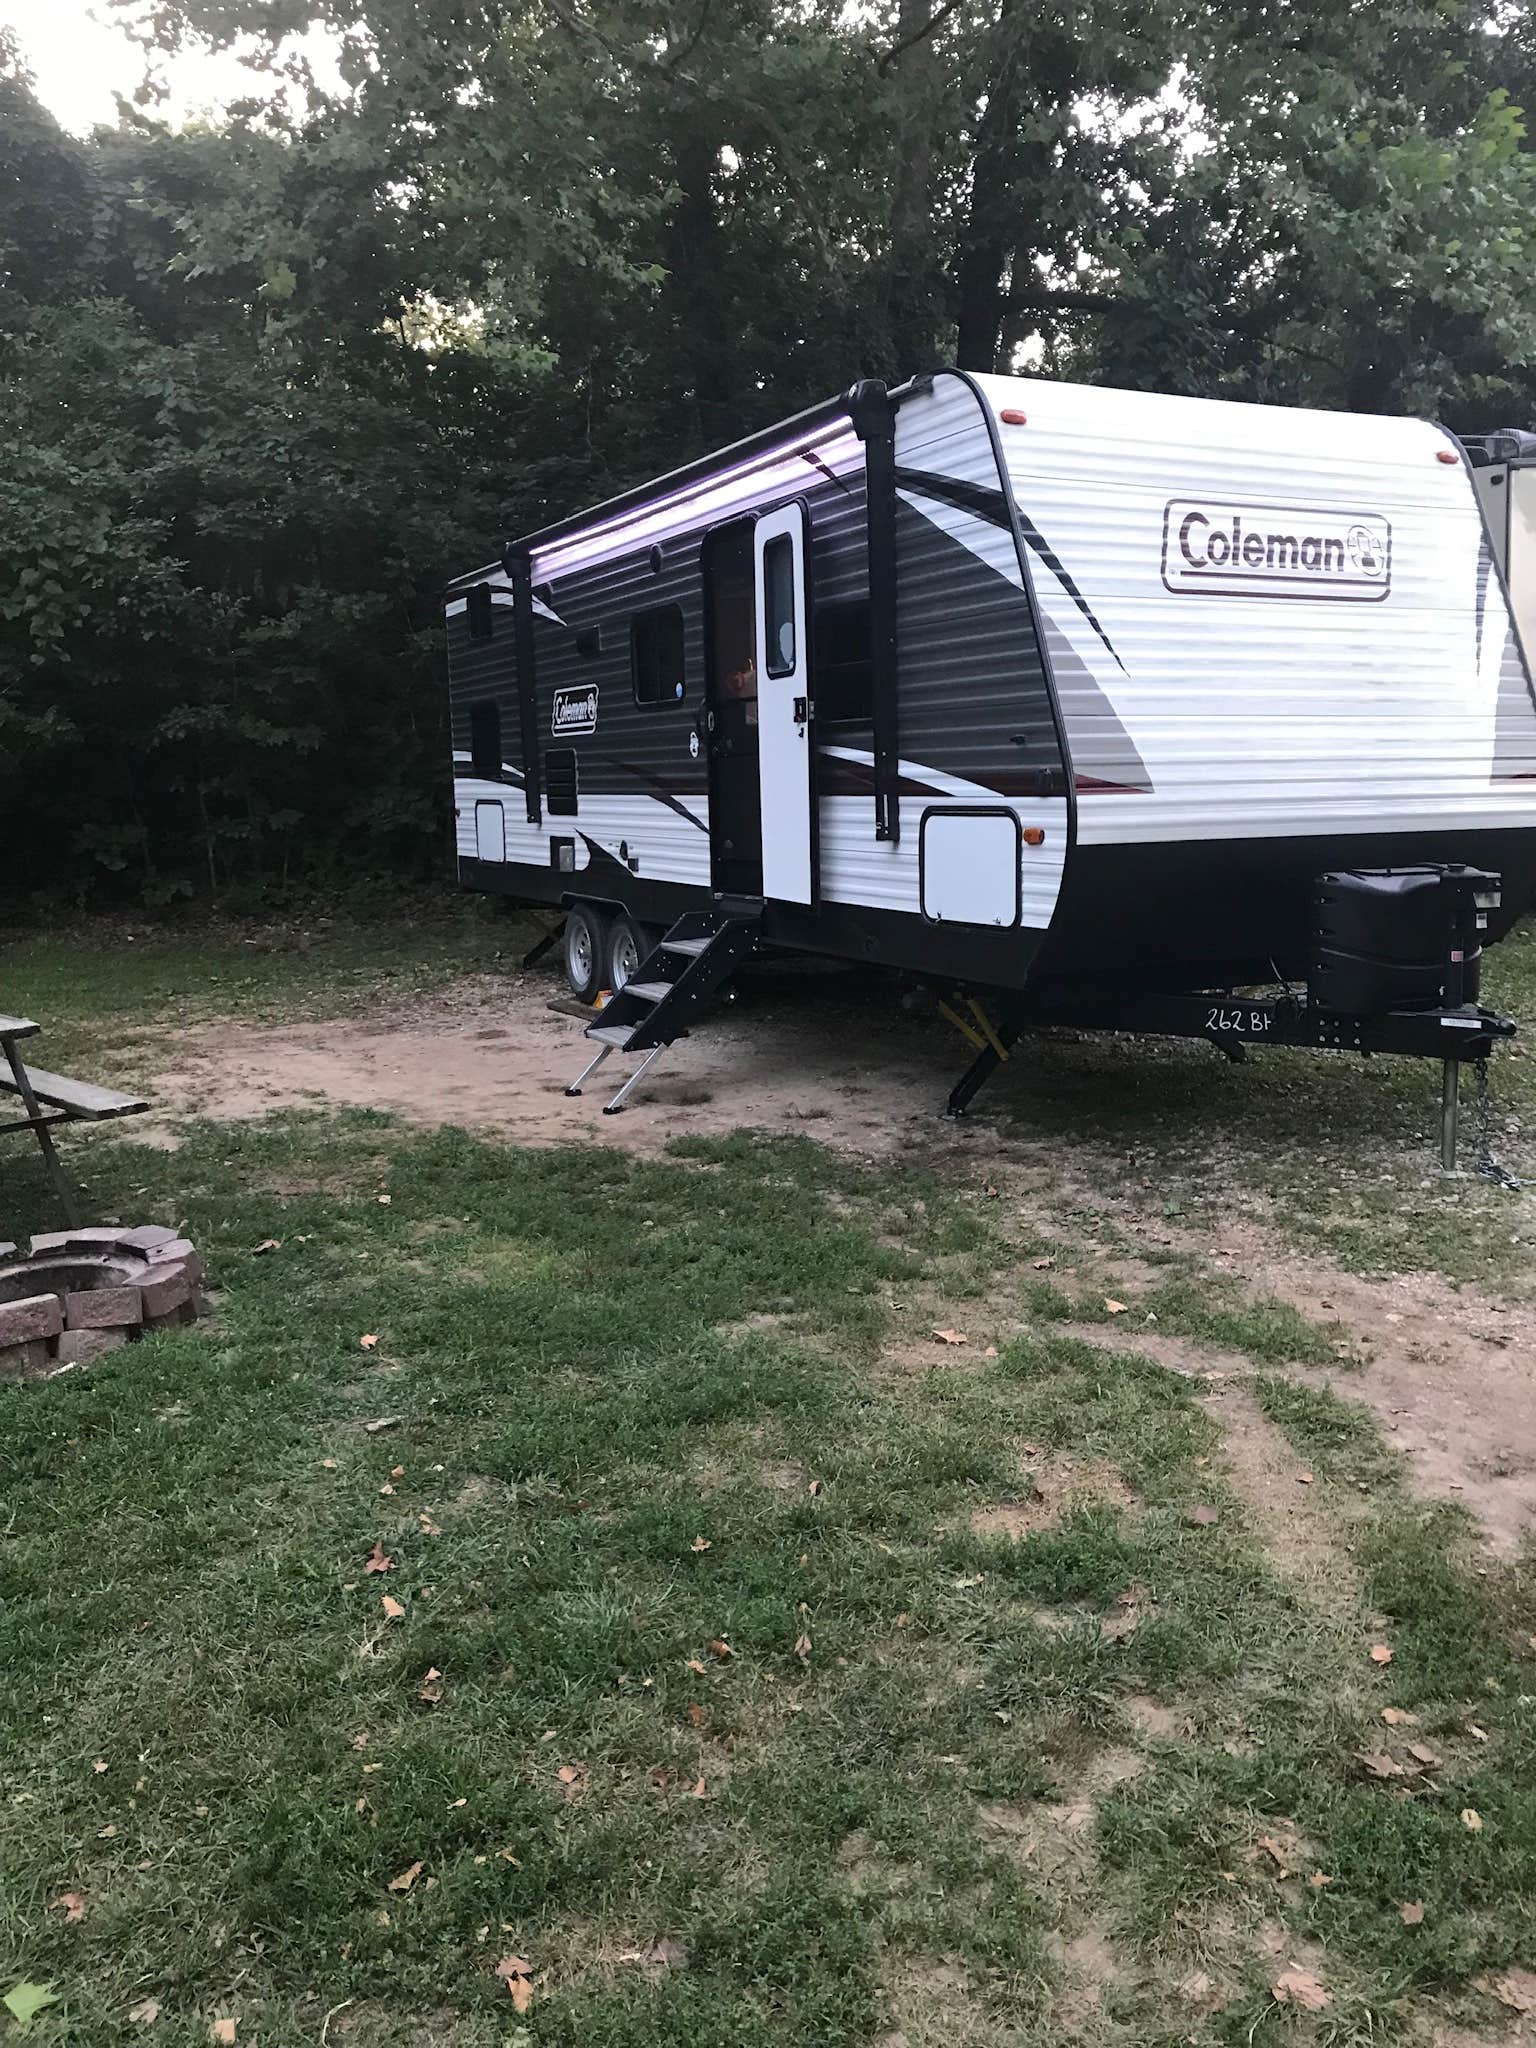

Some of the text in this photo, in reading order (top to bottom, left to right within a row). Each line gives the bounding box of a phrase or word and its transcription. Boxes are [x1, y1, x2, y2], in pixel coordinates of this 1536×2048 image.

[1179, 512, 1345, 573] Coleman
[555, 695, 588, 724] Coleman
[1205, 1008, 1246, 1032] 262
